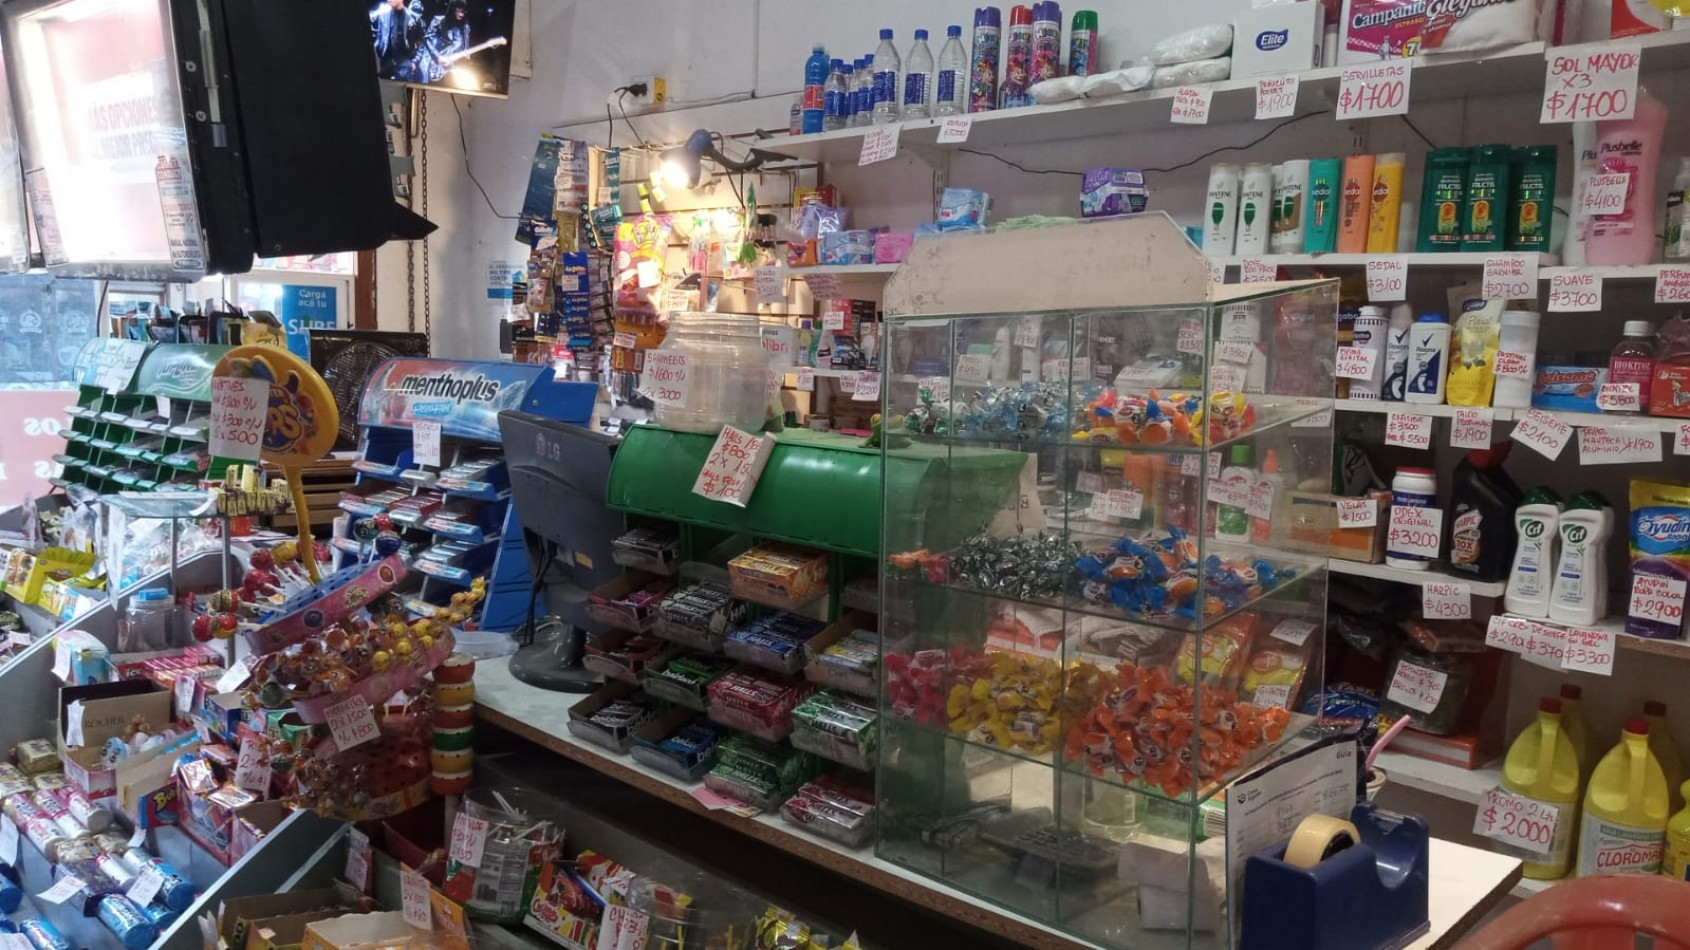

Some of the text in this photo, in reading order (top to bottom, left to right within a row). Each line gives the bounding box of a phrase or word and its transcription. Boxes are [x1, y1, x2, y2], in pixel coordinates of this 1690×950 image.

[1353, 1, 1426, 30] Campanit
[1260, 34, 1286, 46] Elite
[1552, 53, 1638, 76] SOL MAYOR
[1343, 66, 1404, 82] SERVILLETAS
[1340, 80, 1404, 114] $1700
[1547, 90, 1627, 119] $1700
[1582, 150, 1597, 161] Plu
[1368, 261, 1402, 271] SEDAL
[1553, 275, 1594, 286] SUAVE
[1485, 282, 1530, 299] $2700
[1551, 289, 1598, 307] $3700
[401, 373, 501, 405] menthoplus
[660, 387, 681, 400] 3000
[1453, 427, 1488, 443] $1900
[1518, 419, 1559, 448] $2100
[1341, 501, 1367, 510] VELAS
[1526, 522, 1542, 536] Cif
[1569, 527, 1585, 541] Cif
[1389, 528, 1438, 548] $3200
[1424, 600, 1469, 617] $4300
[1632, 597, 1682, 619] $2900
[1489, 628, 1524, 647] $290
[1526, 636, 1563, 660] $370
[1565, 646, 1611, 665] $3300
[1527, 802, 1538, 817] 2
[1596, 849, 1662, 868] CLOROMA
